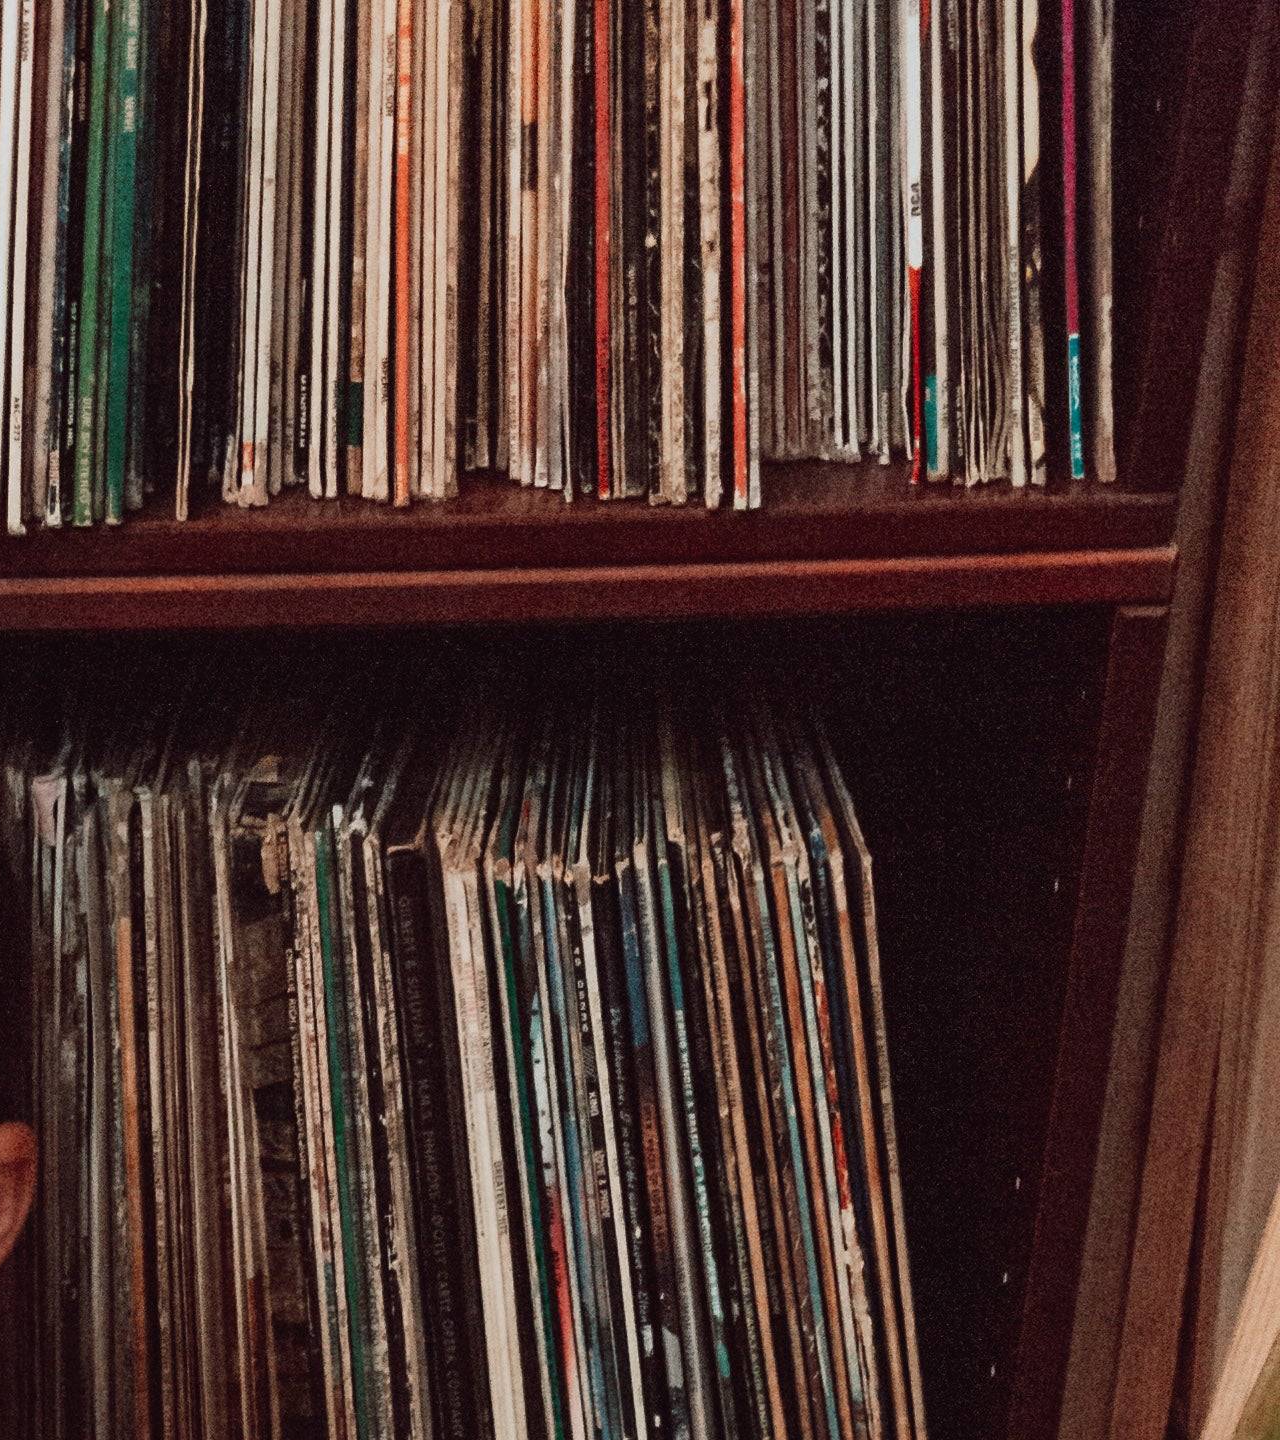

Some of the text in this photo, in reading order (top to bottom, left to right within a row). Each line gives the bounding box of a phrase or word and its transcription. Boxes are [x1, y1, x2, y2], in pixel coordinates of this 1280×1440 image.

[385, 33, 394, 68] SANDY
[910, 182, 920, 216] RCA
[81, 396, 91, 426] BLUE
[79, 458, 90, 505] STEREO
[397, 895, 416, 952] GILBERT
[403, 958, 417, 970] &
[404, 975, 426, 1045] SULLIVAN
[587, 1090, 599, 1117] KING
[592, 1148, 606, 1176] LOVE
[492, 1159, 505, 1210] GREATEST
[598, 1188, 610, 1218] PRIDE
[435, 1270, 452, 1312] CARTE
[440, 1319, 458, 1364] OPERA
[445, 1370, 465, 1438] COMPANY
